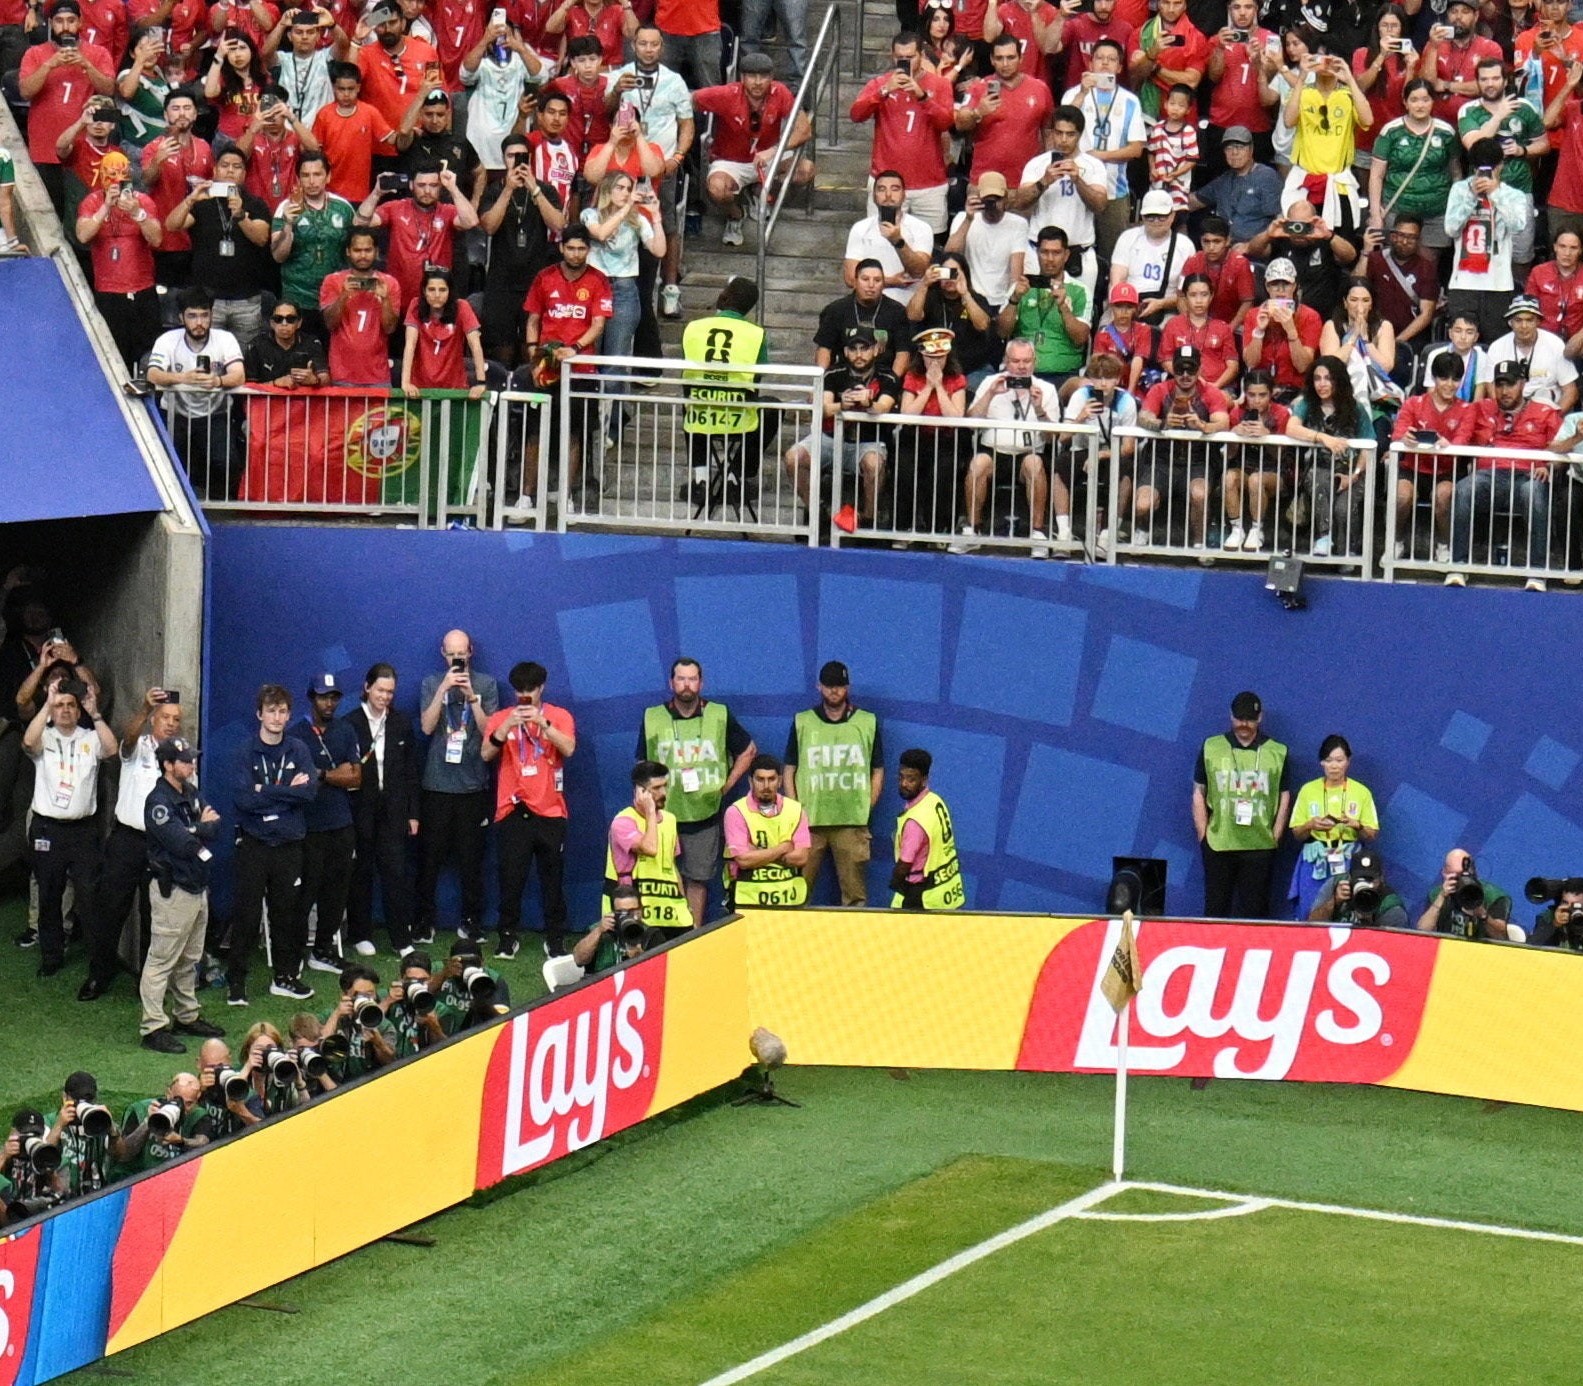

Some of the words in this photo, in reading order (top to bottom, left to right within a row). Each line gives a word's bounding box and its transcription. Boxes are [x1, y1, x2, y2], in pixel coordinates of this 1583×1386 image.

[88, 28, 97, 44] 7
[454, 26, 464, 48] 7
[1240, 63, 1250, 85] 7
[1549, 66, 1558, 85] 7
[62, 82, 72, 104] 7
[399, 75, 408, 95] 7
[497, 101, 507, 120] 7
[906, 110, 915, 133] 7
[91, 168, 100, 187] 7
[1059, 179, 1074, 197] 13
[1143, 262, 1161, 281] 03
[357, 310, 367, 332] 7
[432, 339, 440, 355] 7
[689, 389, 745, 402] ECURITY
[657, 738, 719, 764] FIFA
[807, 744, 866, 769] FIFA
[810, 772, 867, 792] PITCH
[1074, 922, 1392, 1079] Lay's
[503, 971, 646, 1174] Lay's
